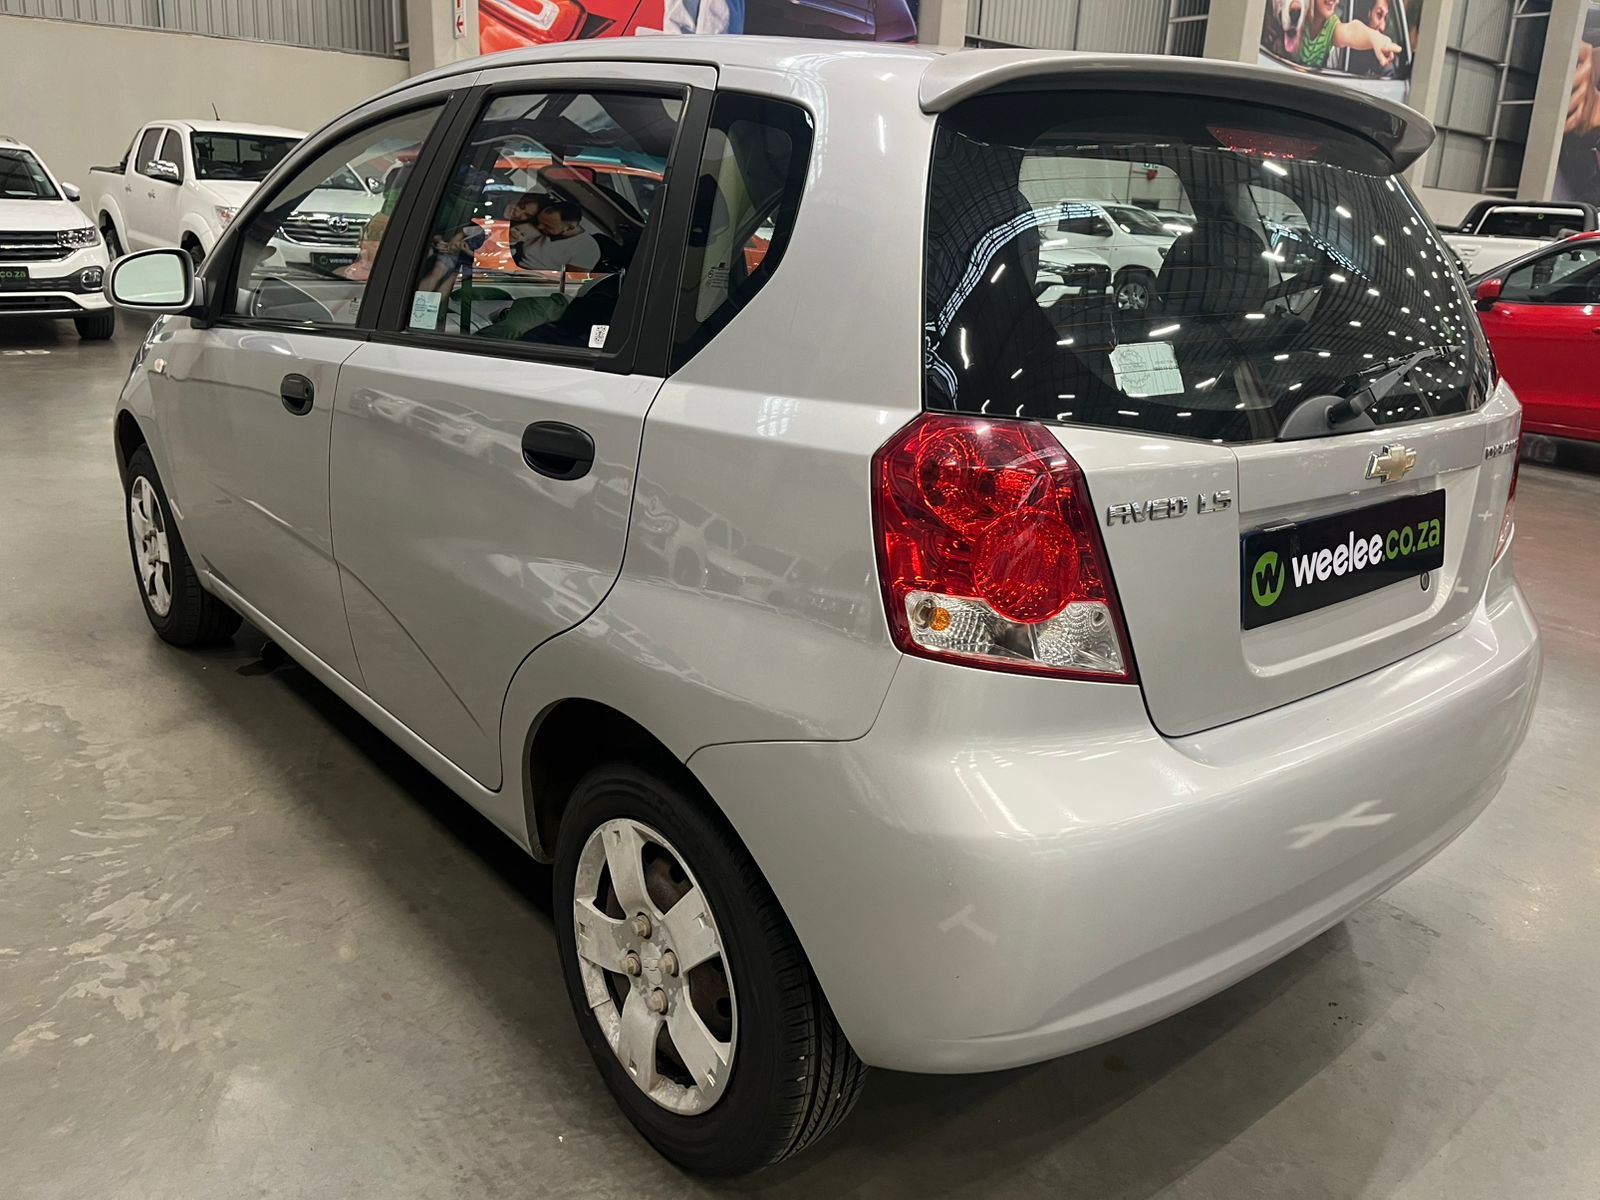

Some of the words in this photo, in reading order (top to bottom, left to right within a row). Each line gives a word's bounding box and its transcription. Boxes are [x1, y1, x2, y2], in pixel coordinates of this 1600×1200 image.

[1106, 496, 1188, 526] AVEO
[1197, 490, 1231, 514] LS
[1291, 518, 1441, 588] weelee.co.za
